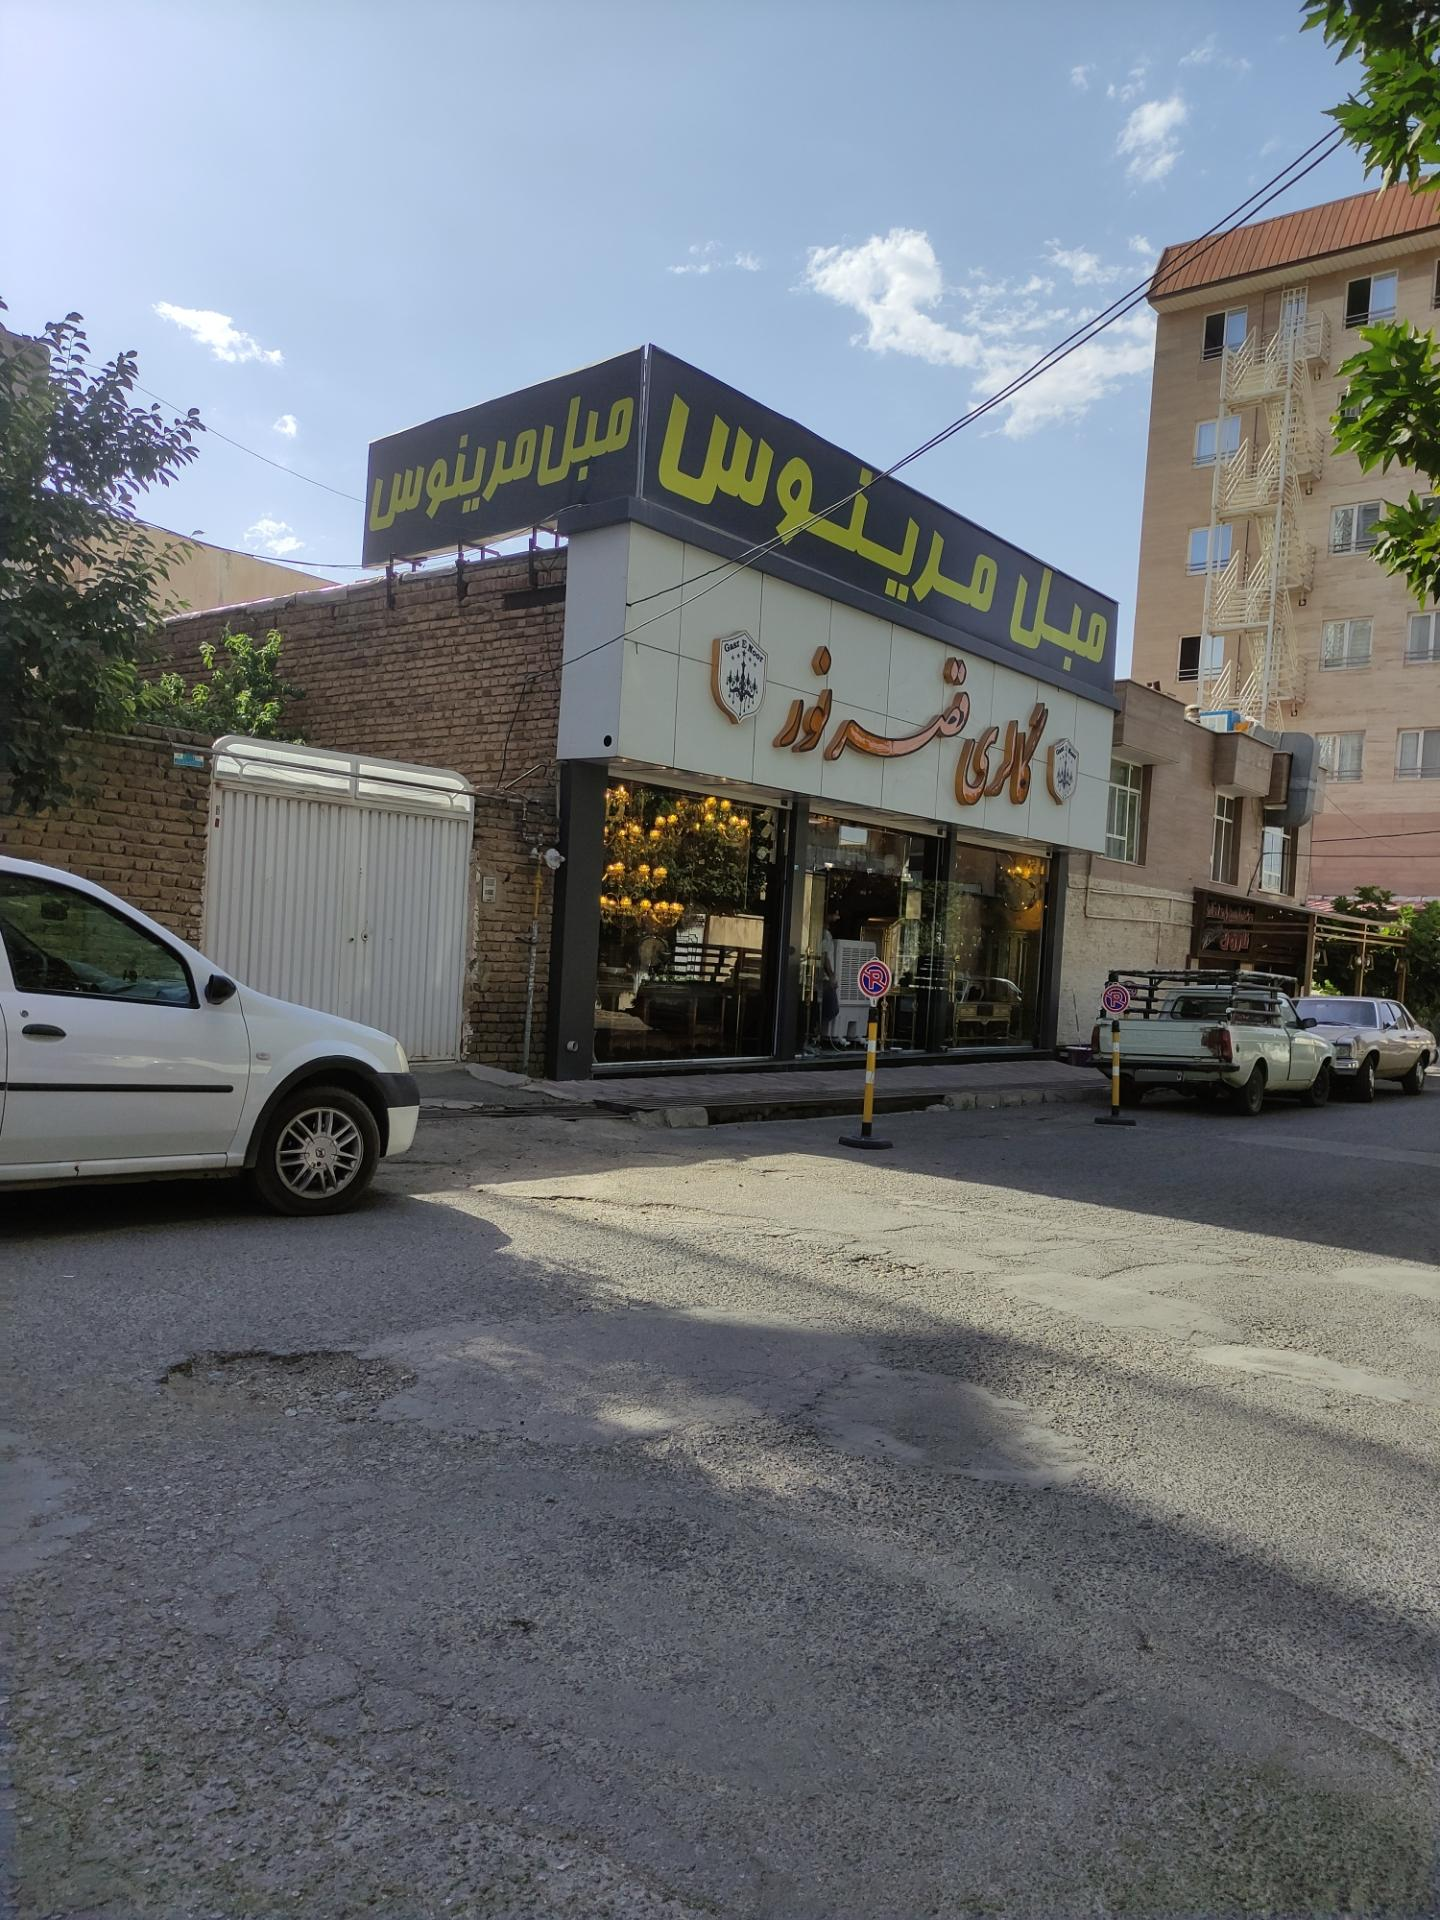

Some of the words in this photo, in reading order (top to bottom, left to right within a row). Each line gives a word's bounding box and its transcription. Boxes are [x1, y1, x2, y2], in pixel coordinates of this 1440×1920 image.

[369, 428, 537, 532] مرینوس
[537, 395, 634, 487] مبل
[658, 393, 998, 613] مرینوس
[1009, 566, 1108, 671] مبل
[772, 645, 832, 753] نور
[823, 656, 971, 761] قصر
[955, 702, 1049, 806] گالری
